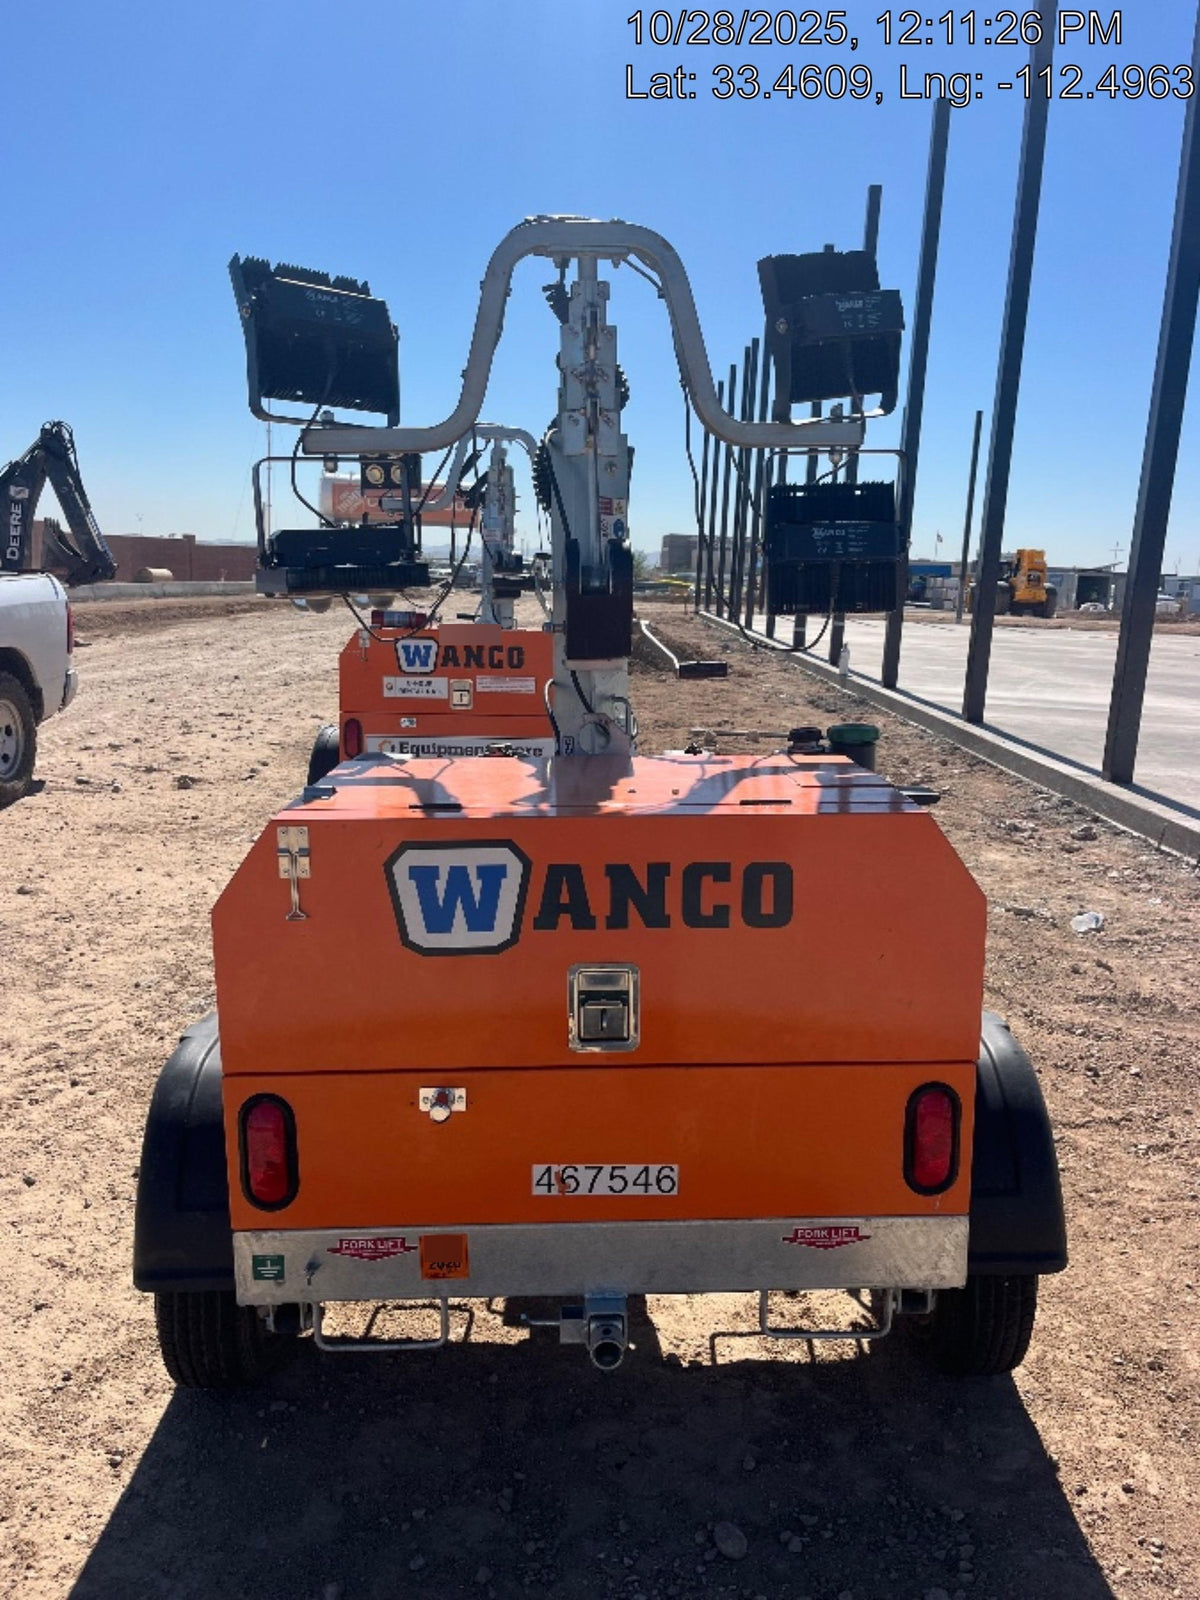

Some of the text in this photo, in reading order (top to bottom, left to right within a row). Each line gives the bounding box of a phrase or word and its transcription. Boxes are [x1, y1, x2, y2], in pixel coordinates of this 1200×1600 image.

[6, 502, 23, 561] DEERE
[400, 643, 525, 670] WANCO
[407, 861, 794, 935] WANCO
[534, 1164, 677, 1195] 467546
[342, 1238, 402, 1250] FORK LIFT
[797, 1227, 857, 1239] FORK LIFT
